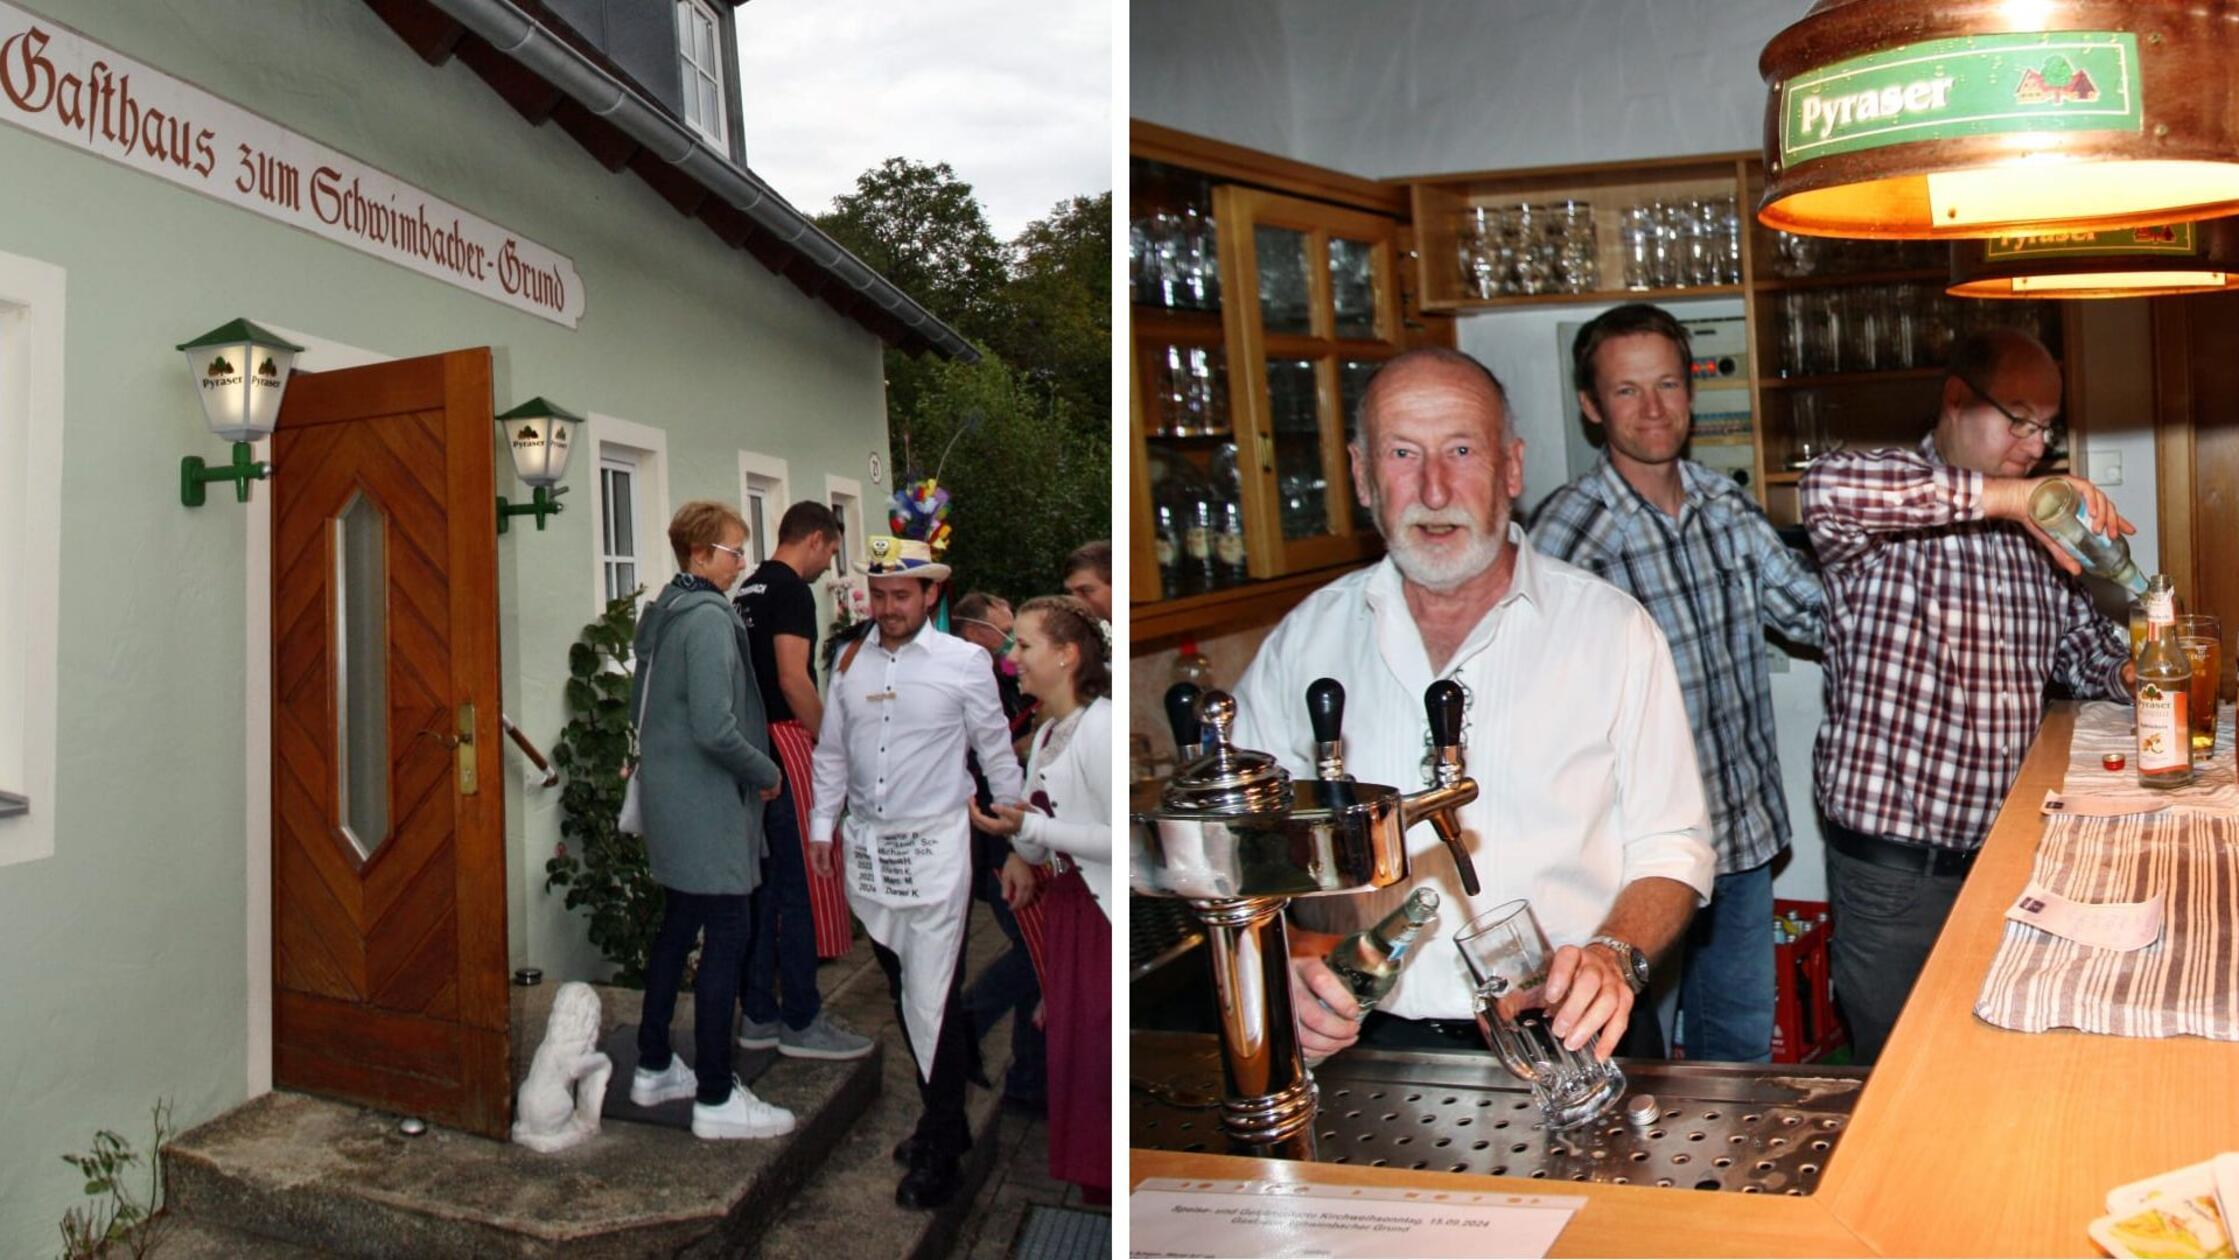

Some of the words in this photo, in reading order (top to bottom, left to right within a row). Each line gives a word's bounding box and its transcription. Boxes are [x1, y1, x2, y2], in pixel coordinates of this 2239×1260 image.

[1800, 76, 1957, 138] Pyraser
[235, 142, 301, 212] zum
[202, 376, 242, 390] Pyraser
[513, 440, 544, 449] Pyraser
